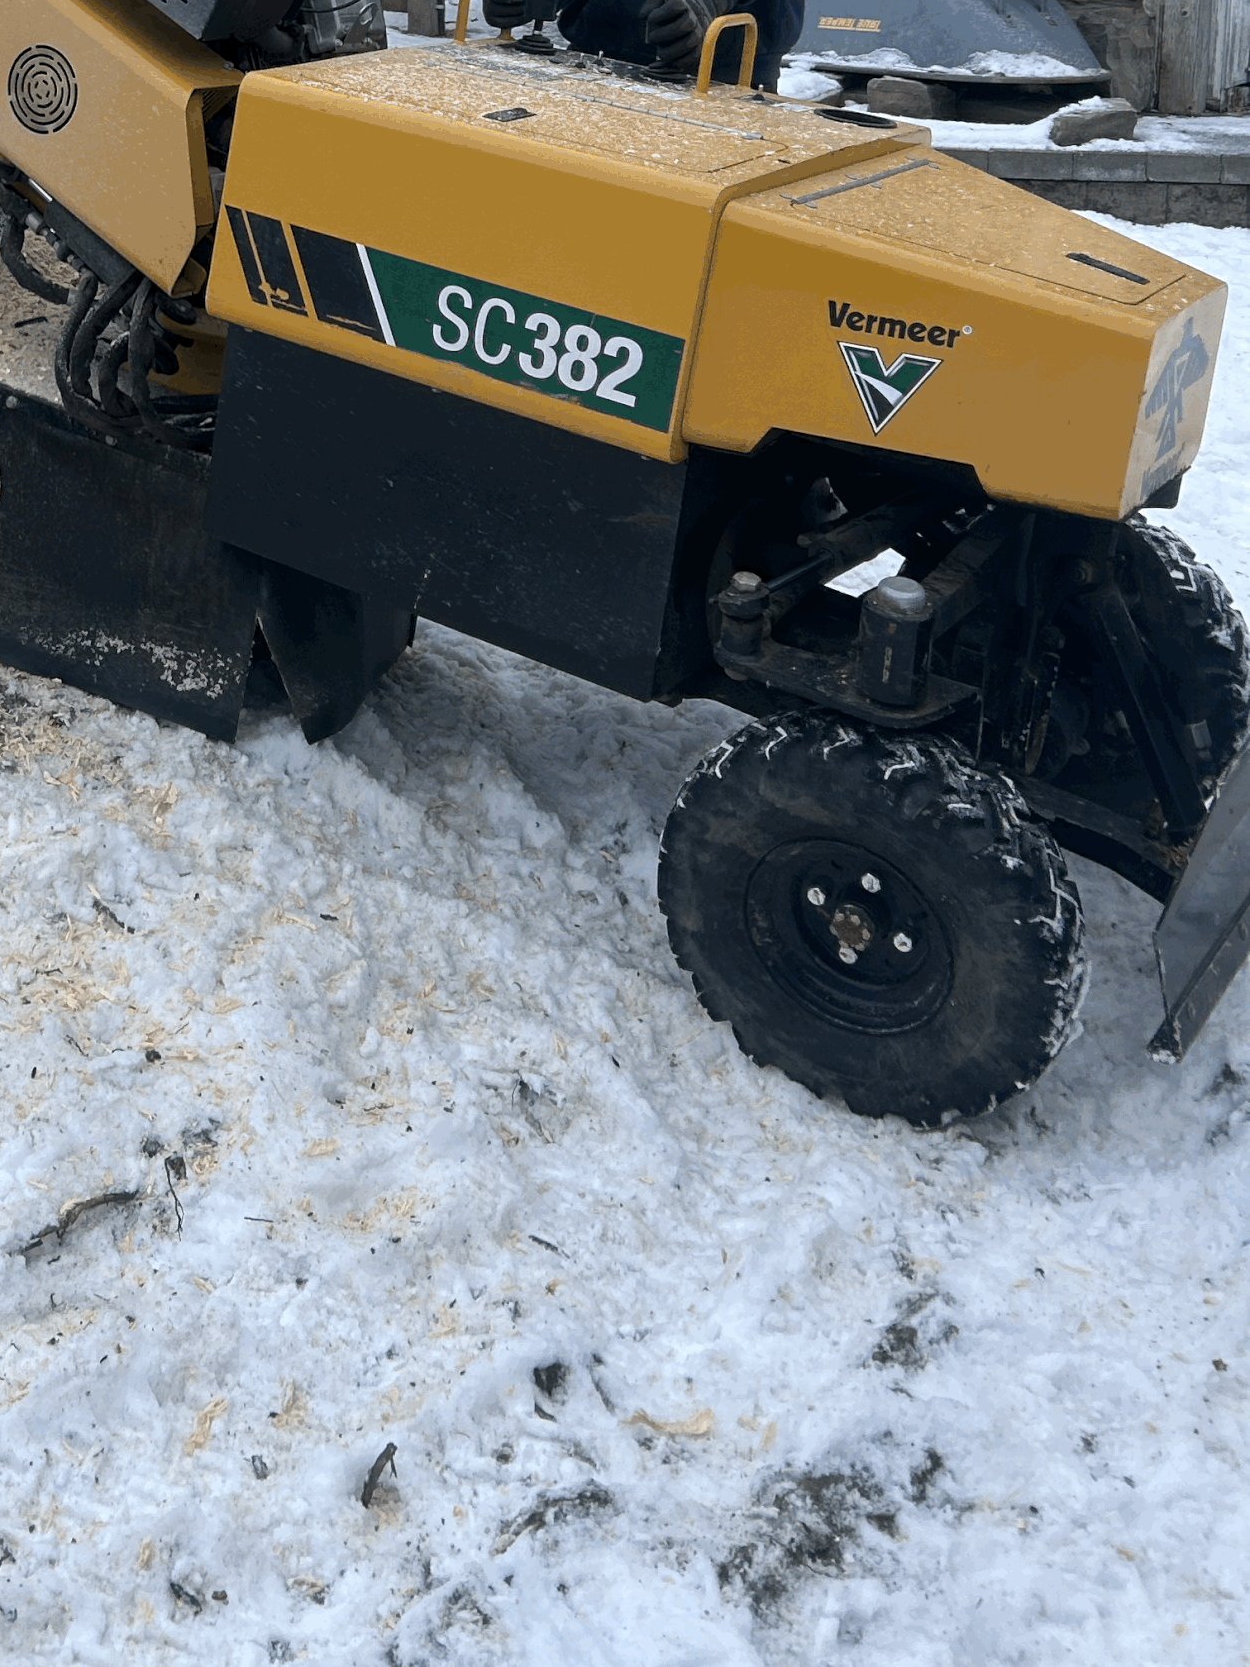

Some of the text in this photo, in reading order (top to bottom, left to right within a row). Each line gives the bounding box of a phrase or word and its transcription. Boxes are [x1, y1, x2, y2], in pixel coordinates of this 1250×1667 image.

[817, 16, 881, 32] TRUE TEMPER
[432, 284, 644, 408] SC382
